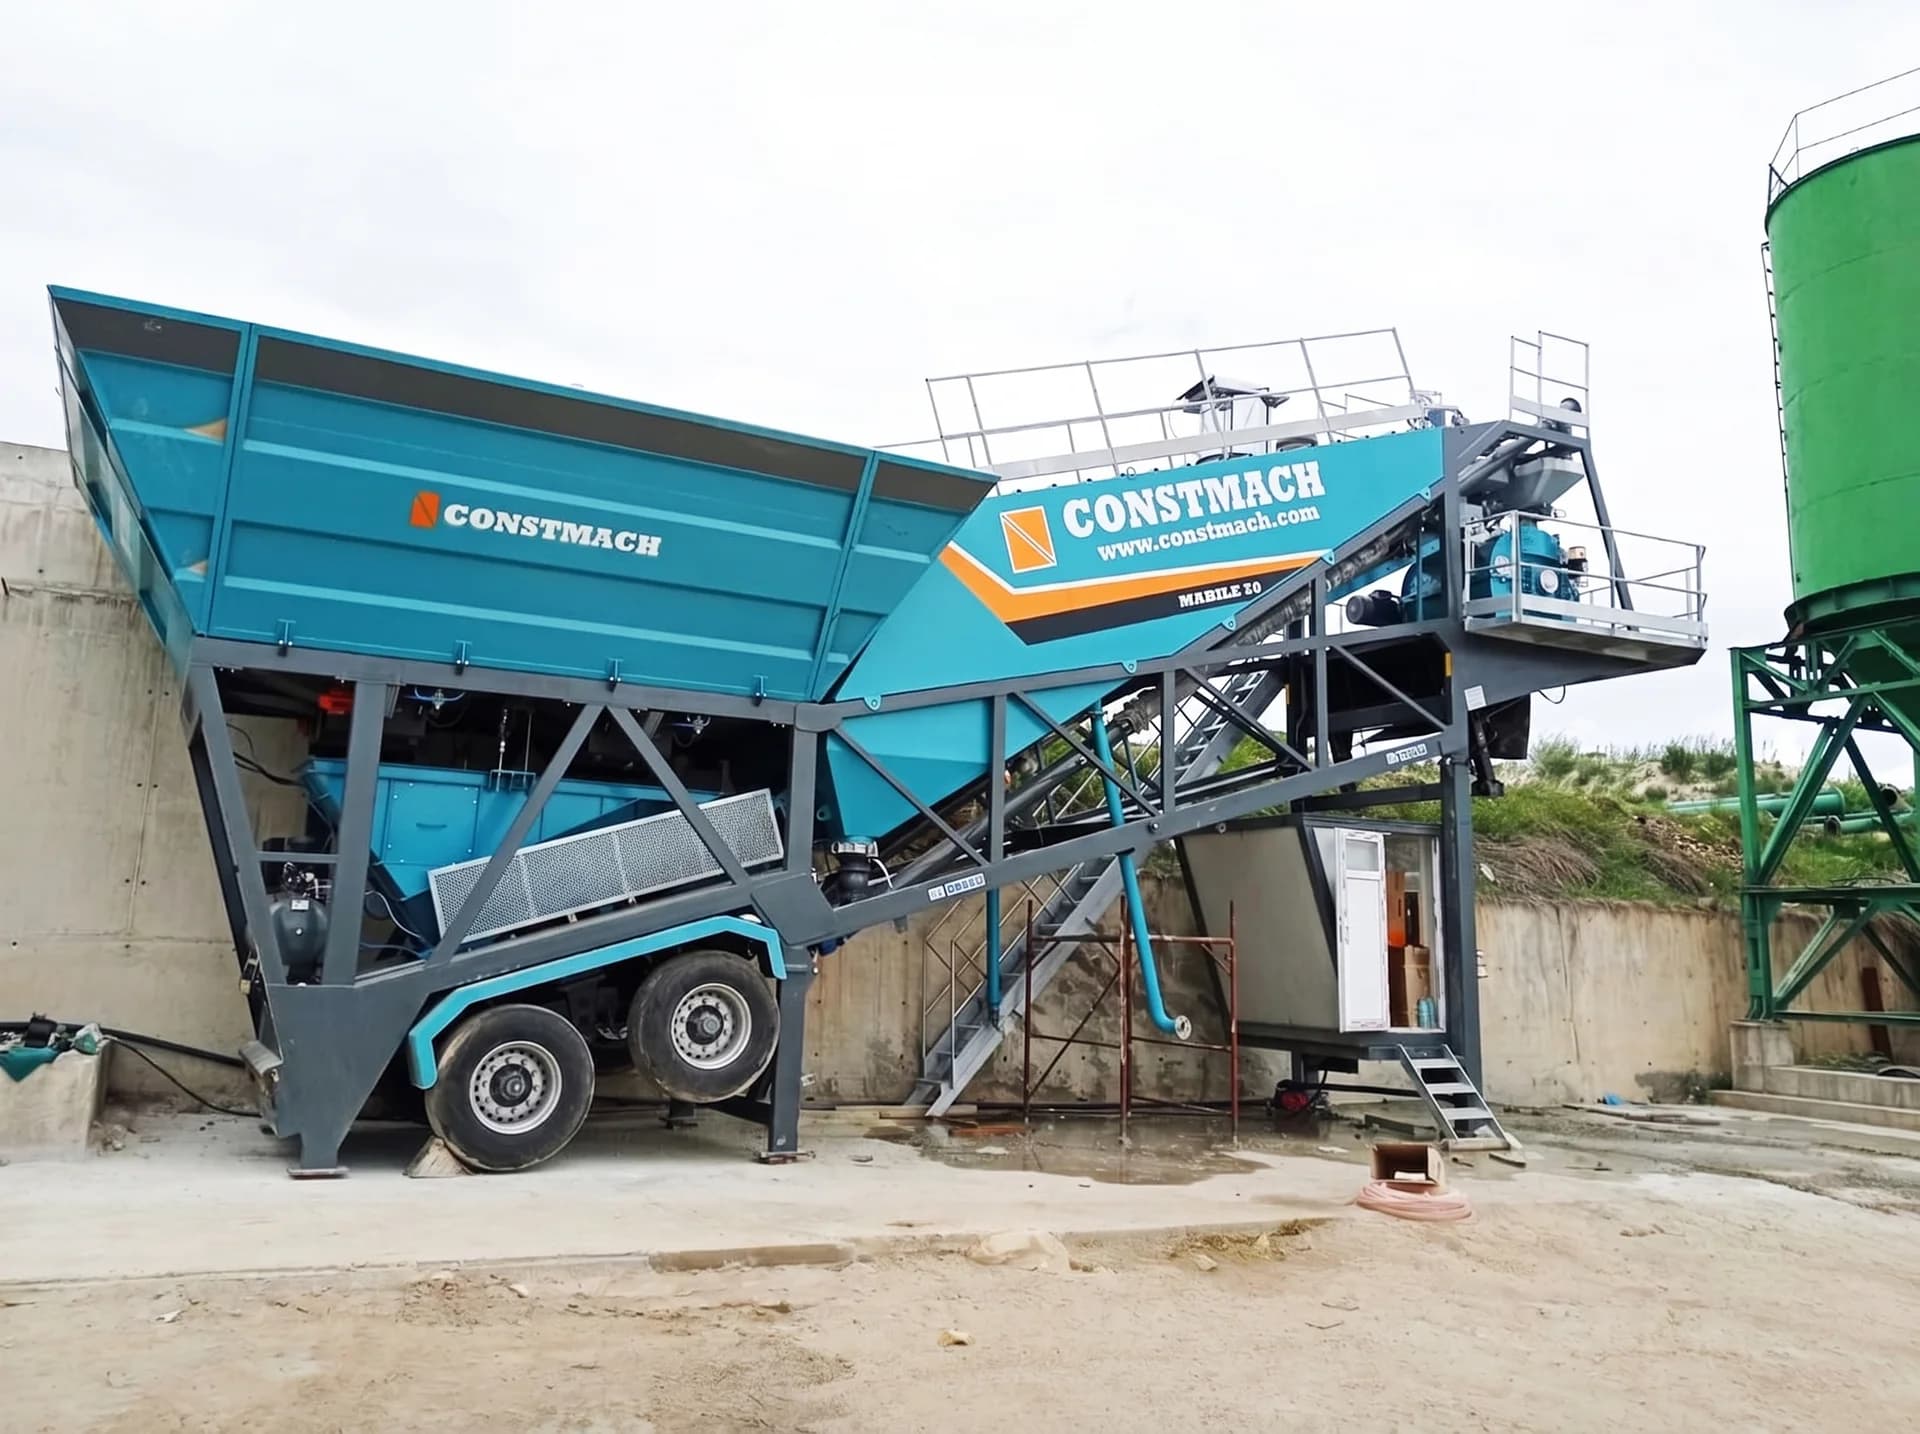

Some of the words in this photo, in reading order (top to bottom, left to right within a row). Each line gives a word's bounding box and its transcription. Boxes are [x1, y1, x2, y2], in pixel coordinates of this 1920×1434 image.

[1062, 460, 1326, 538] CONSTMACH
[443, 503, 662, 557] CONSTMACH
[1097, 505, 1320, 561] www.constmach.com
